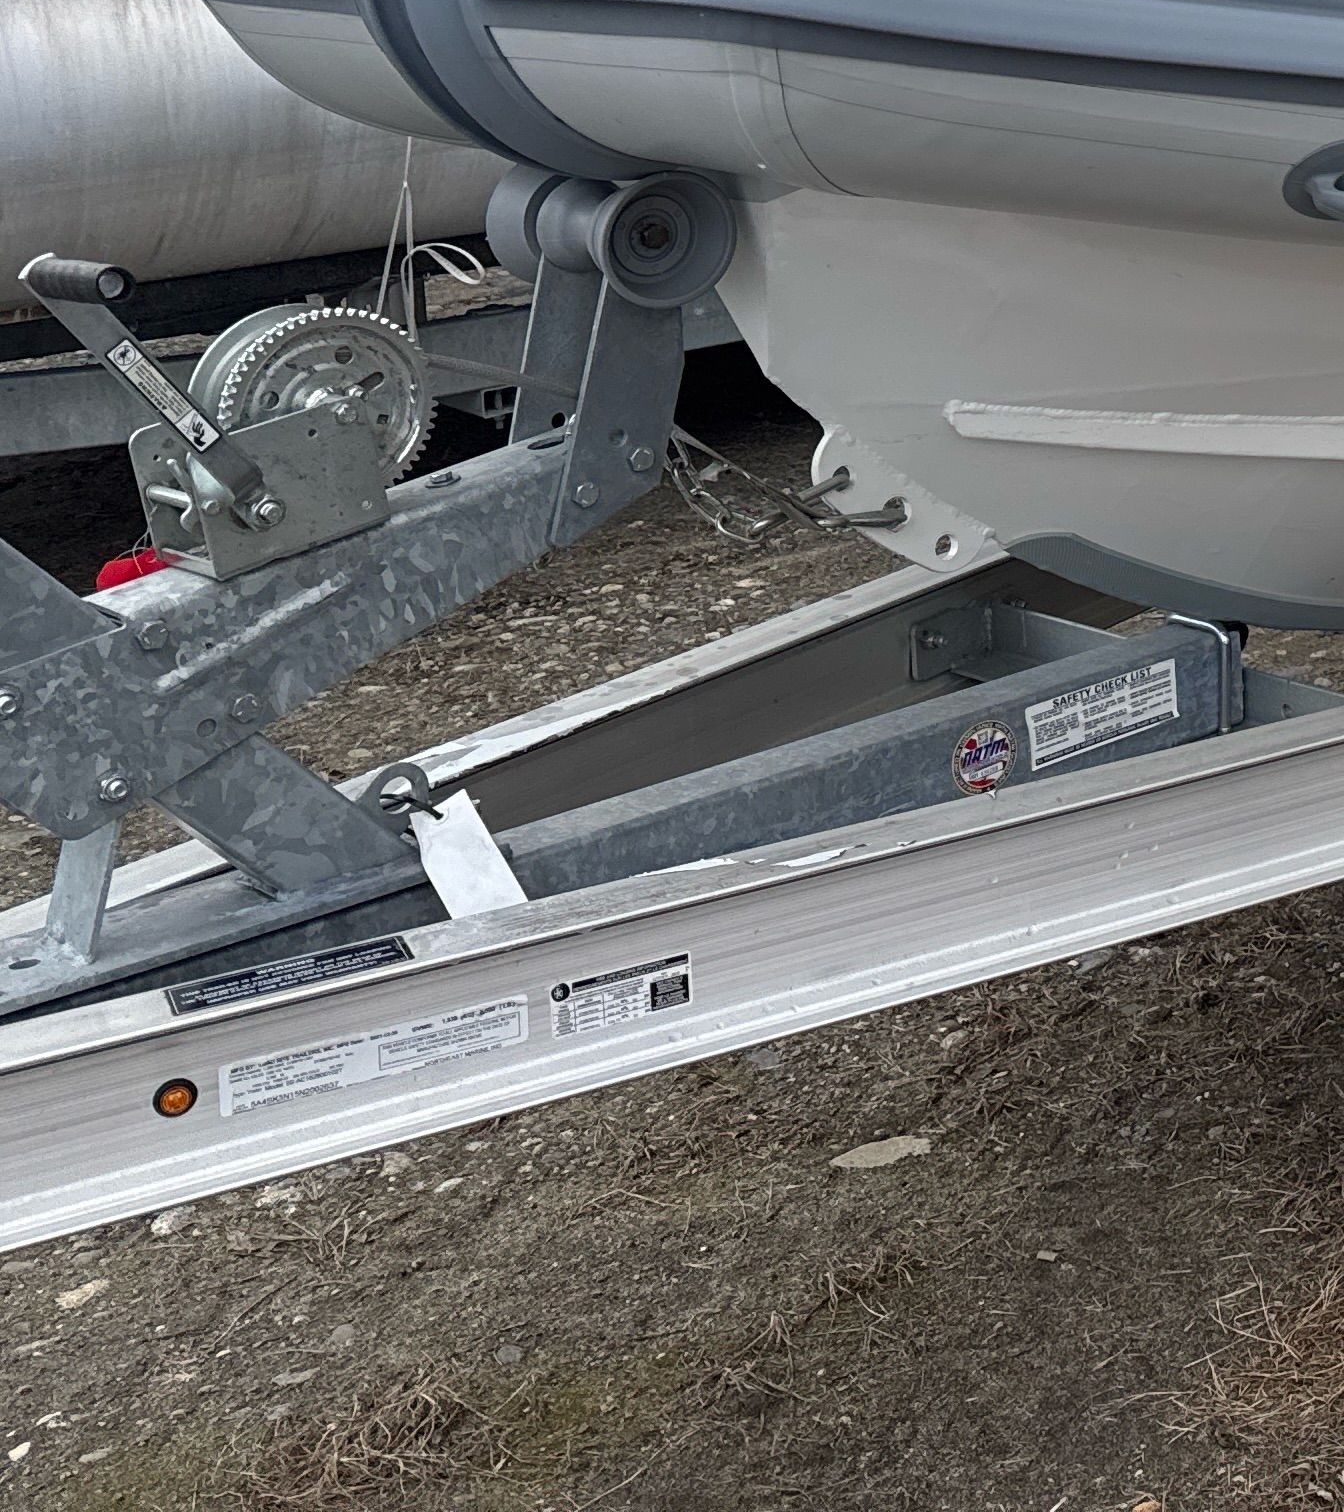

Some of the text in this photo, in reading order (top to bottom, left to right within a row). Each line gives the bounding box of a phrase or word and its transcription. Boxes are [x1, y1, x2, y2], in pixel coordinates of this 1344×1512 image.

[1052, 667, 1152, 709] SAFETY CHECK LIST
